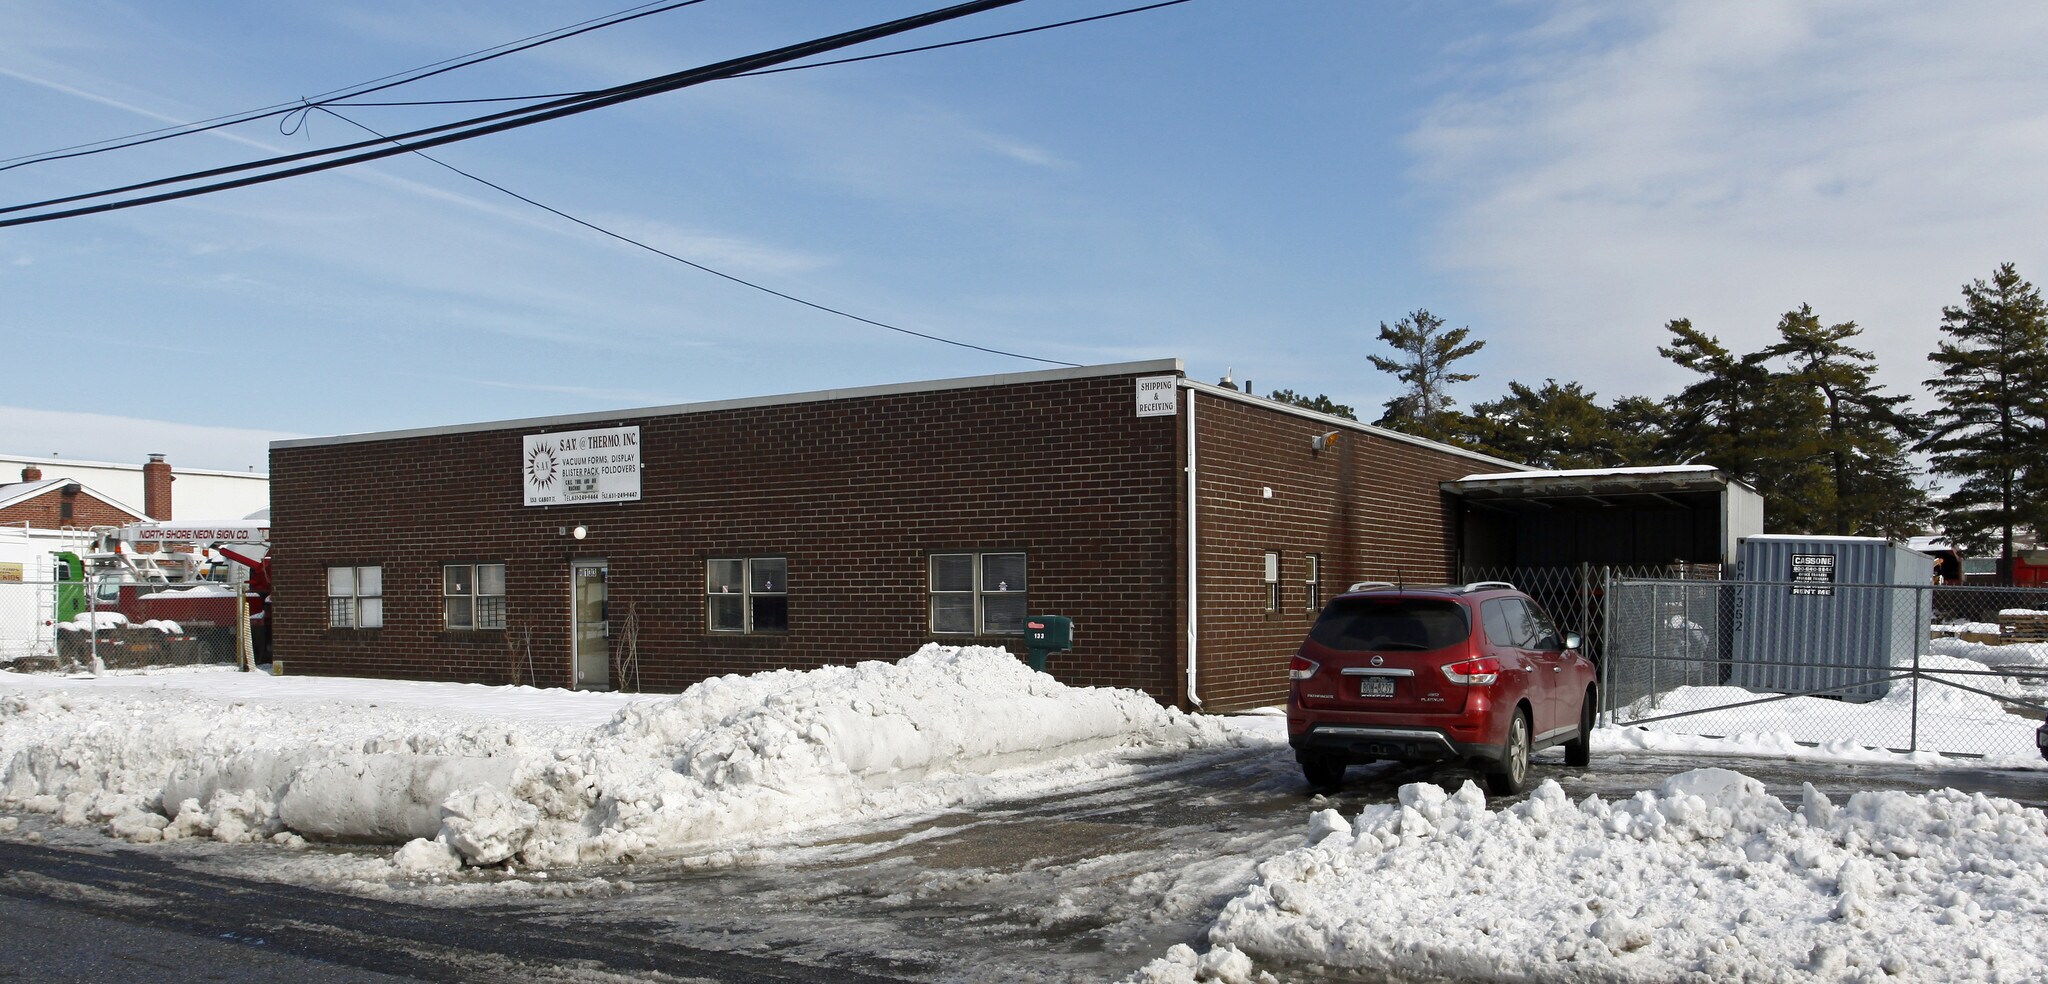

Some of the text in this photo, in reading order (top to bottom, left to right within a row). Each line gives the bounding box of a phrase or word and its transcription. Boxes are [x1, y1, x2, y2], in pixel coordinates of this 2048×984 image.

[1141, 381, 1172, 391] SHIPPING
[1153, 392, 1159, 400] &
[1139, 402, 1173, 412] RECEIVING
[623, 432, 638, 446] INC.
[562, 457, 587, 466] VACUUM
[611, 453, 635, 463] DISPLAY
[562, 467, 583, 477] BLISTER
[601, 464, 636, 475] FOLDOVERS
[139, 530, 250, 539] NORTH SHORE NEON SIGN CO.
[1795, 557, 1832, 565] CASSONE
